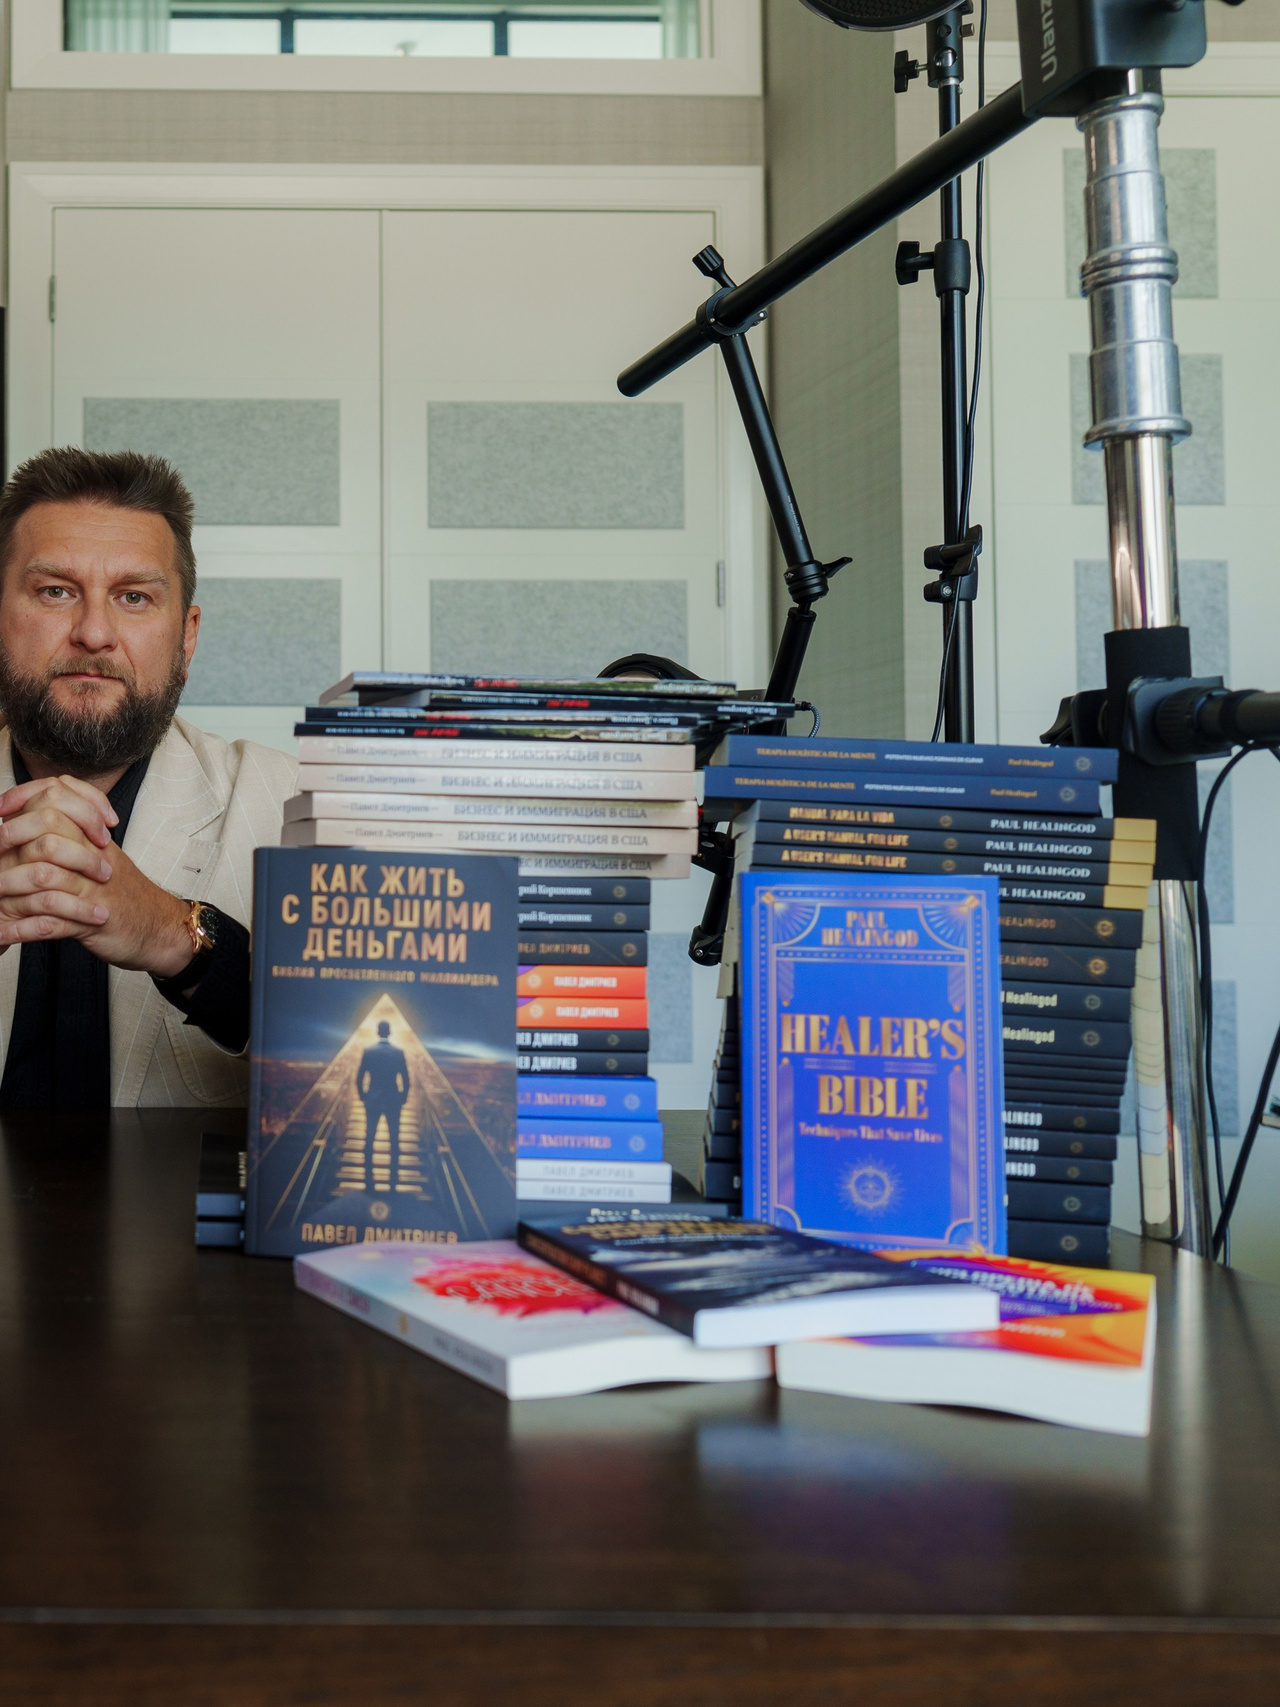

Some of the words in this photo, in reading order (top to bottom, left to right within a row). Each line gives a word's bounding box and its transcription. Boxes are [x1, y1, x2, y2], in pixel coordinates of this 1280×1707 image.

[1041, 0, 1057, 82] Ulanz
[619, 808, 647, 818] США
[789, 807, 828, 820] MANUAL
[830, 809, 855, 822] PARA
[856, 811, 870, 822] LA
[871, 811, 895, 824] VIDA
[990, 818, 1021, 830] PAUL
[1022, 820, 1096, 834] HEALINGOD
[621, 835, 649, 846] США
[783, 828, 792, 841] A
[867, 833, 886, 846] FOR
[887, 834, 910, 847] LIFE
[985, 840, 1017, 852] PAUL
[1018, 841, 1093, 855] HEALINGOD
[781, 849, 790, 862] A
[865, 854, 884, 867] FOR
[885, 855, 907, 869] LIFE
[983, 862, 1015, 874] PAUL
[1016, 864, 1091, 878] HEALINGOD
[310, 863, 368, 894] КАК
[378, 865, 465, 898] ЖИТЬ
[1011, 887, 1086, 902] HEALINGOD
[281, 894, 300, 925] С
[311, 895, 492, 932] БОЛЬШИМИ
[846, 910, 888, 928] PAUL
[302, 927, 468, 963] ДЕНЬГАМИ
[821, 928, 919, 948] HEALINGOD
[272, 965, 315, 979] БИБЛИЯ
[999, 954, 1049, 968] EALINGOD
[1006, 991, 1058, 1009] Healingod
[780, 1012, 967, 1061] HEALER'S
[816, 1073, 930, 1120] BIBLE
[861, 1126, 884, 1140] That
[886, 1128, 914, 1142] Save
[915, 1130, 944, 1144] Lives
[301, 1222, 357, 1244] ПАВЕЛ
[363, 1226, 459, 1246] ДМИТРИЕВ
